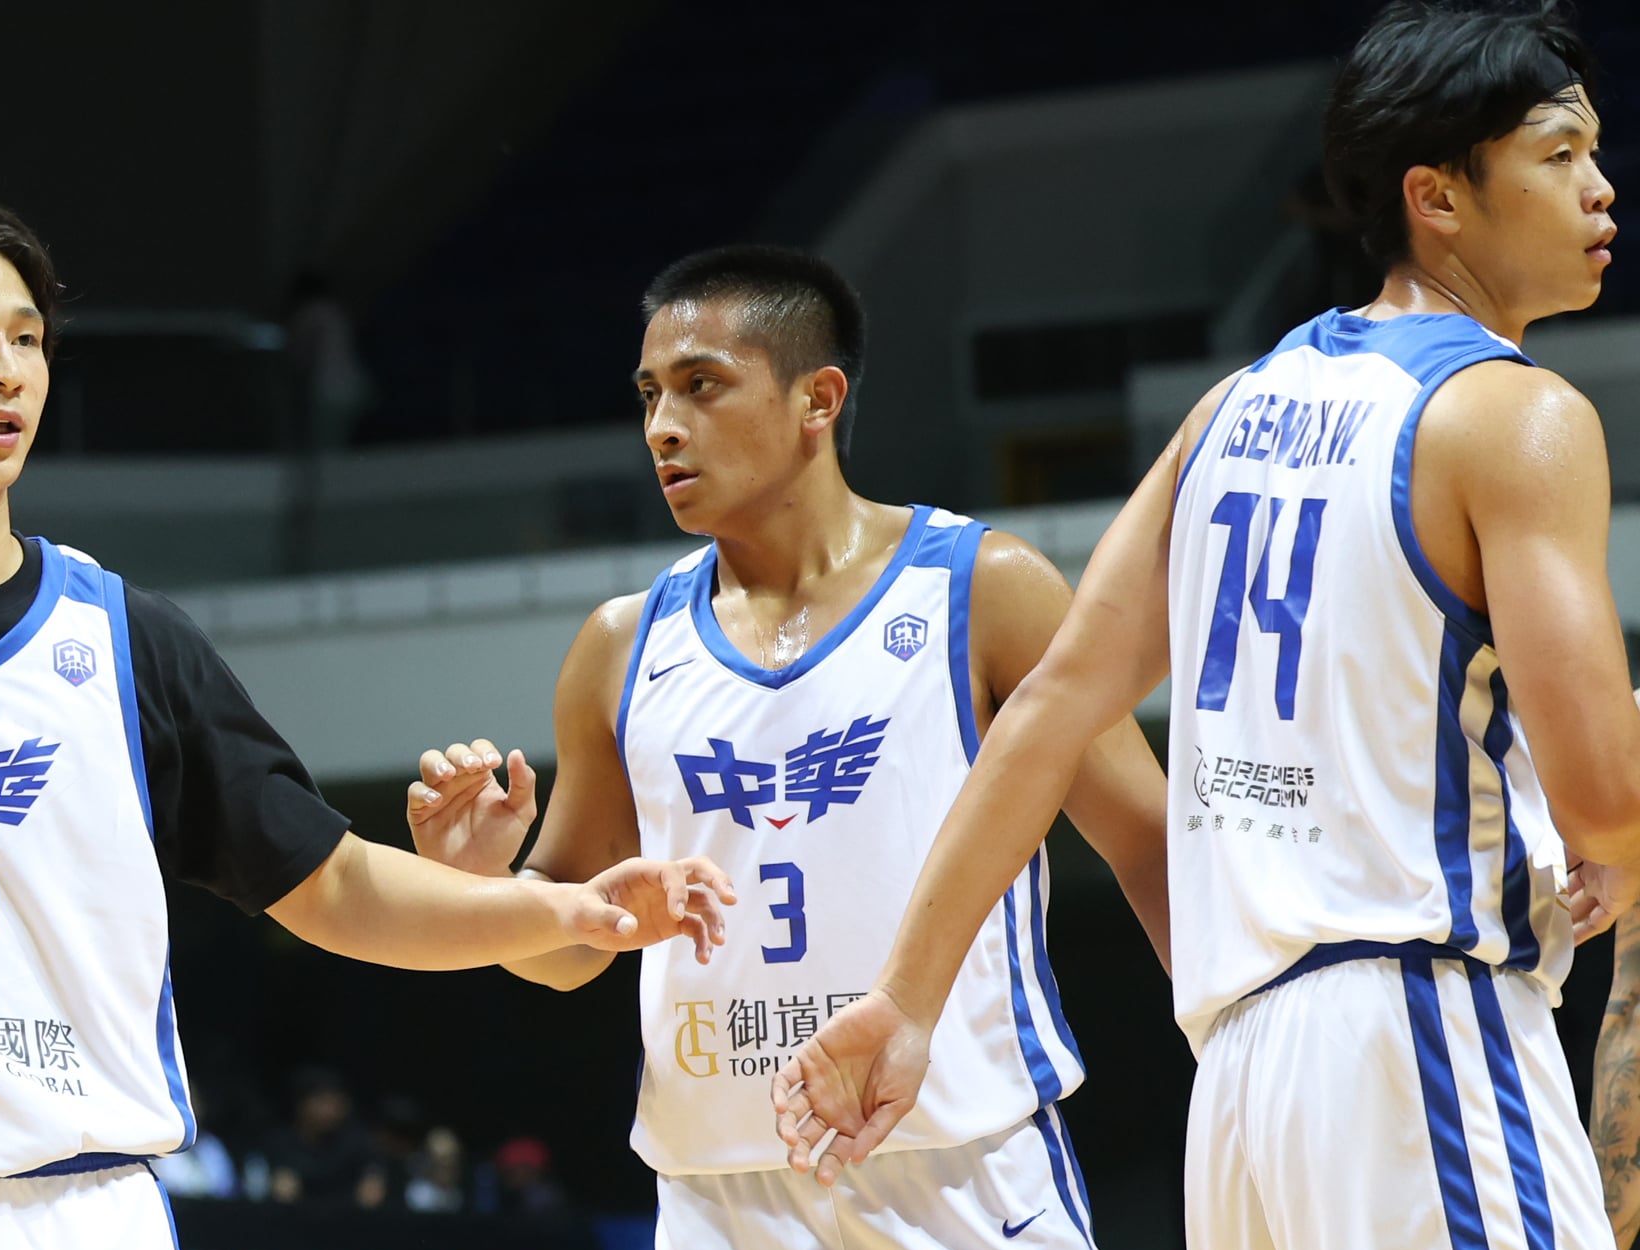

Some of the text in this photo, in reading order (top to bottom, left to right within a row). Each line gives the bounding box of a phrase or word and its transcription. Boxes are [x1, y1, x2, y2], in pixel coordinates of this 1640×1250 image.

[1196, 491, 1328, 721] 14
[674, 714, 891, 831] 中華
[1210, 778, 1308, 808] ACADMY
[759, 862, 807, 964] 3
